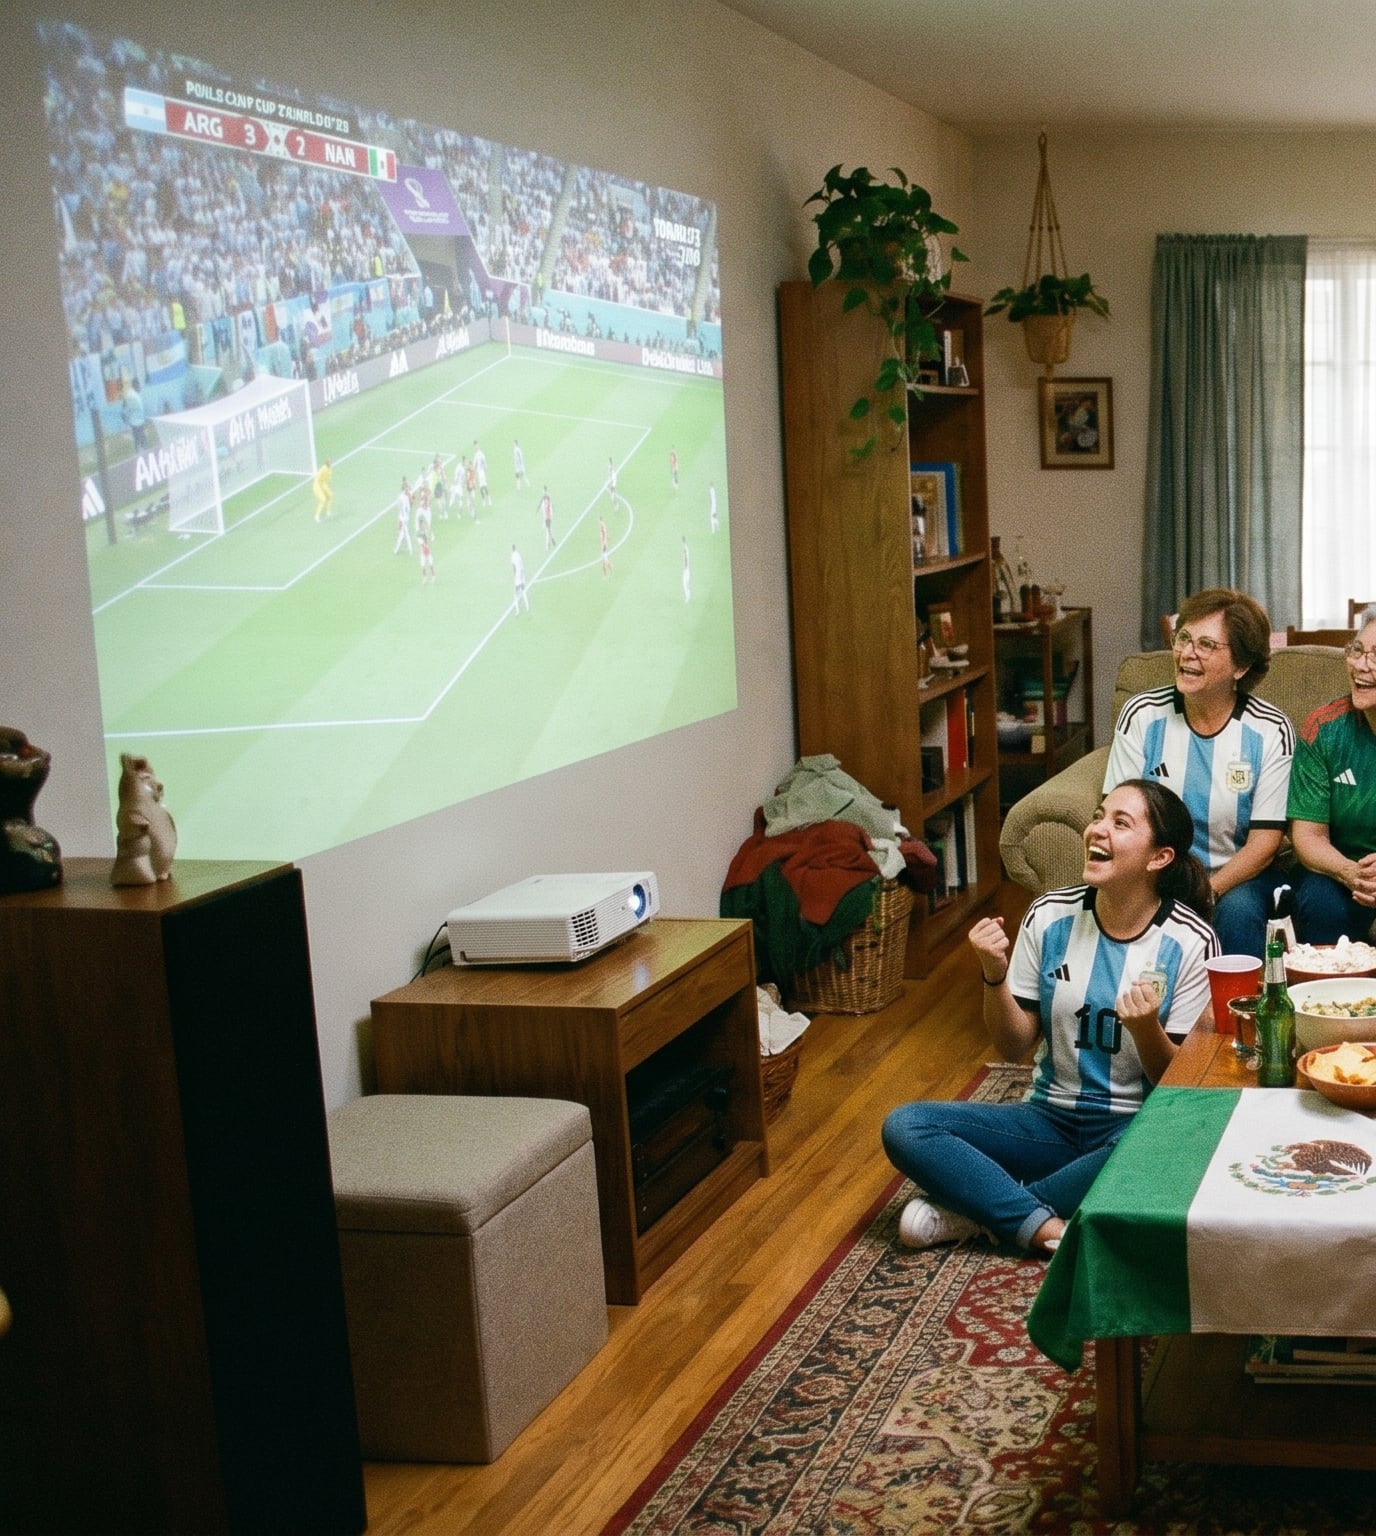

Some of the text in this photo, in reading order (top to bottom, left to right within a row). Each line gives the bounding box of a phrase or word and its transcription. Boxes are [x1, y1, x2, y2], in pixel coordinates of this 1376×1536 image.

[255, 98, 277, 115] CUP
[183, 111, 356, 168] ARG 3 2 NAN
[1074, 1003, 1122, 1055] 10
